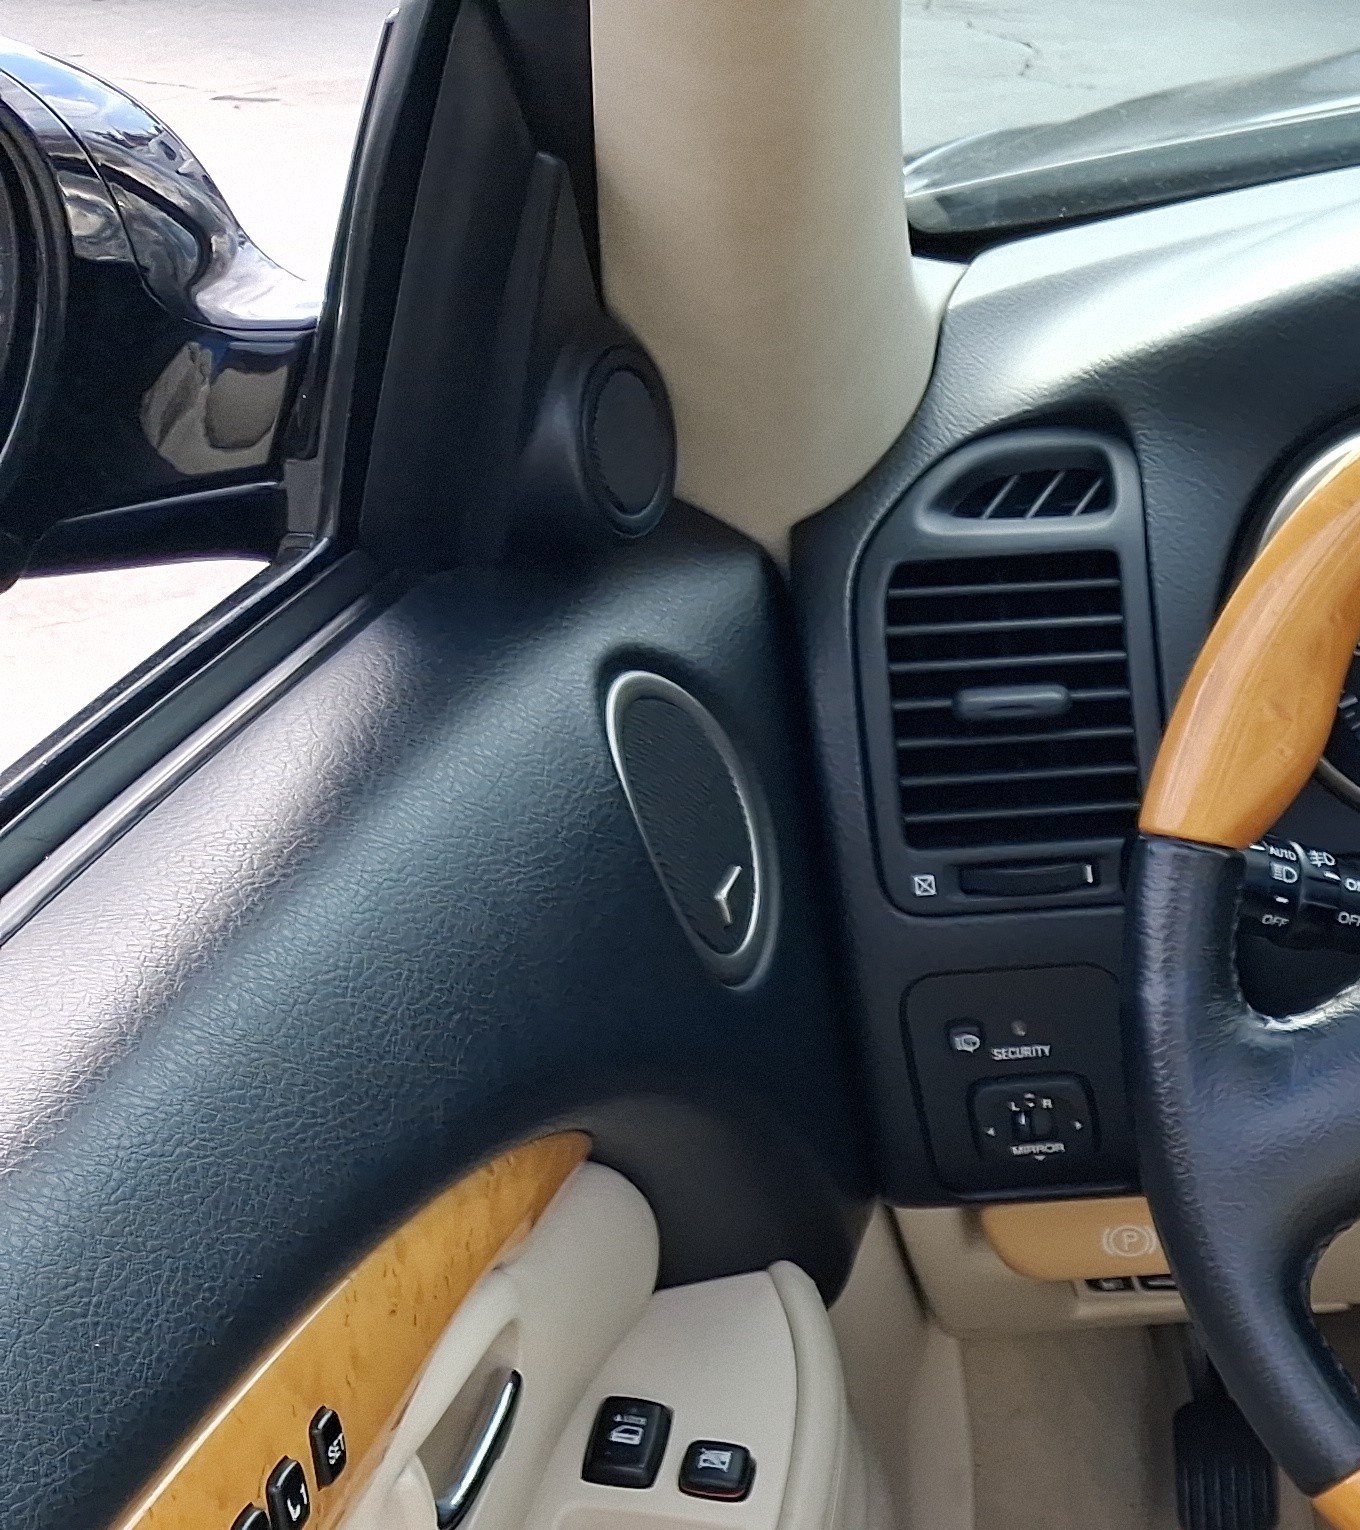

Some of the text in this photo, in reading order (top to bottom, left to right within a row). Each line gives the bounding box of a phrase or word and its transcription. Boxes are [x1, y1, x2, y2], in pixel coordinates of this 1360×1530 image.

[1269, 846, 1297, 861] AUTO
[1262, 915, 1289, 926] OFF
[992, 1045, 1051, 1059] SECURITY
[1010, 1143, 1065, 1156] MIRROR
